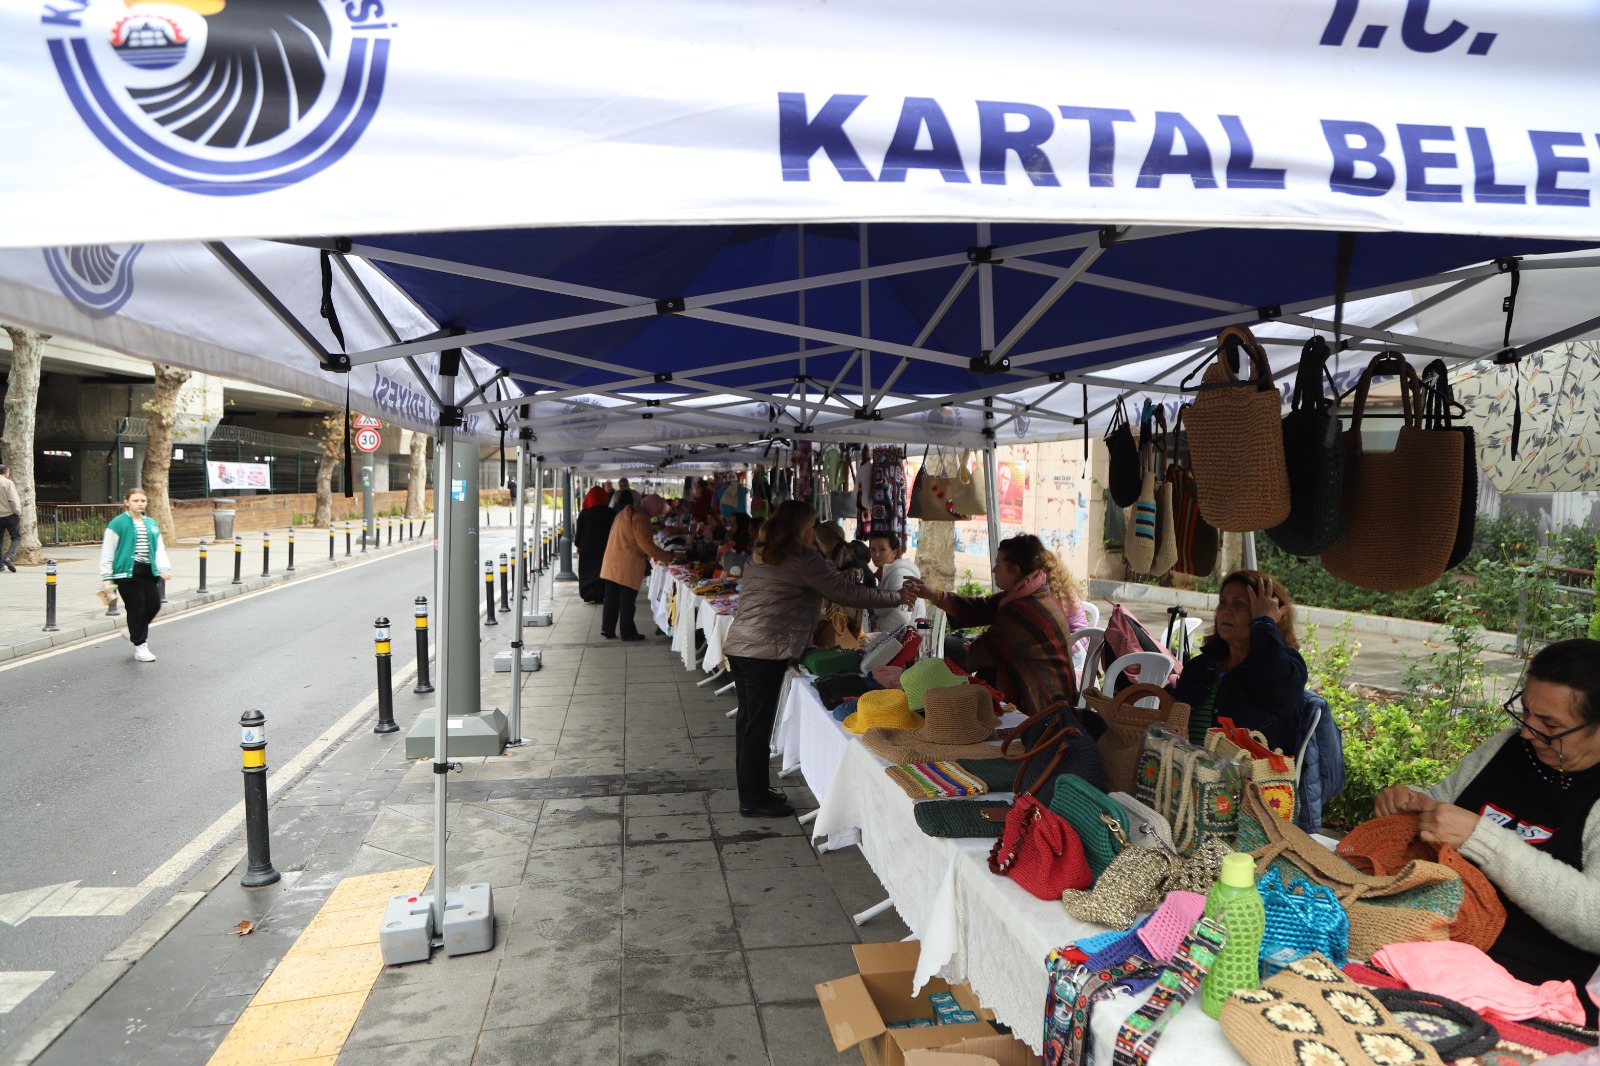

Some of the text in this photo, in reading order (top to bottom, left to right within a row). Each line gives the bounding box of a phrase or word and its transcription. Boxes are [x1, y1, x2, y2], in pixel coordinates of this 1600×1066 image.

[776, 91, 1600, 207] KARTAL BELE
[361, 434, 376, 445] 30
